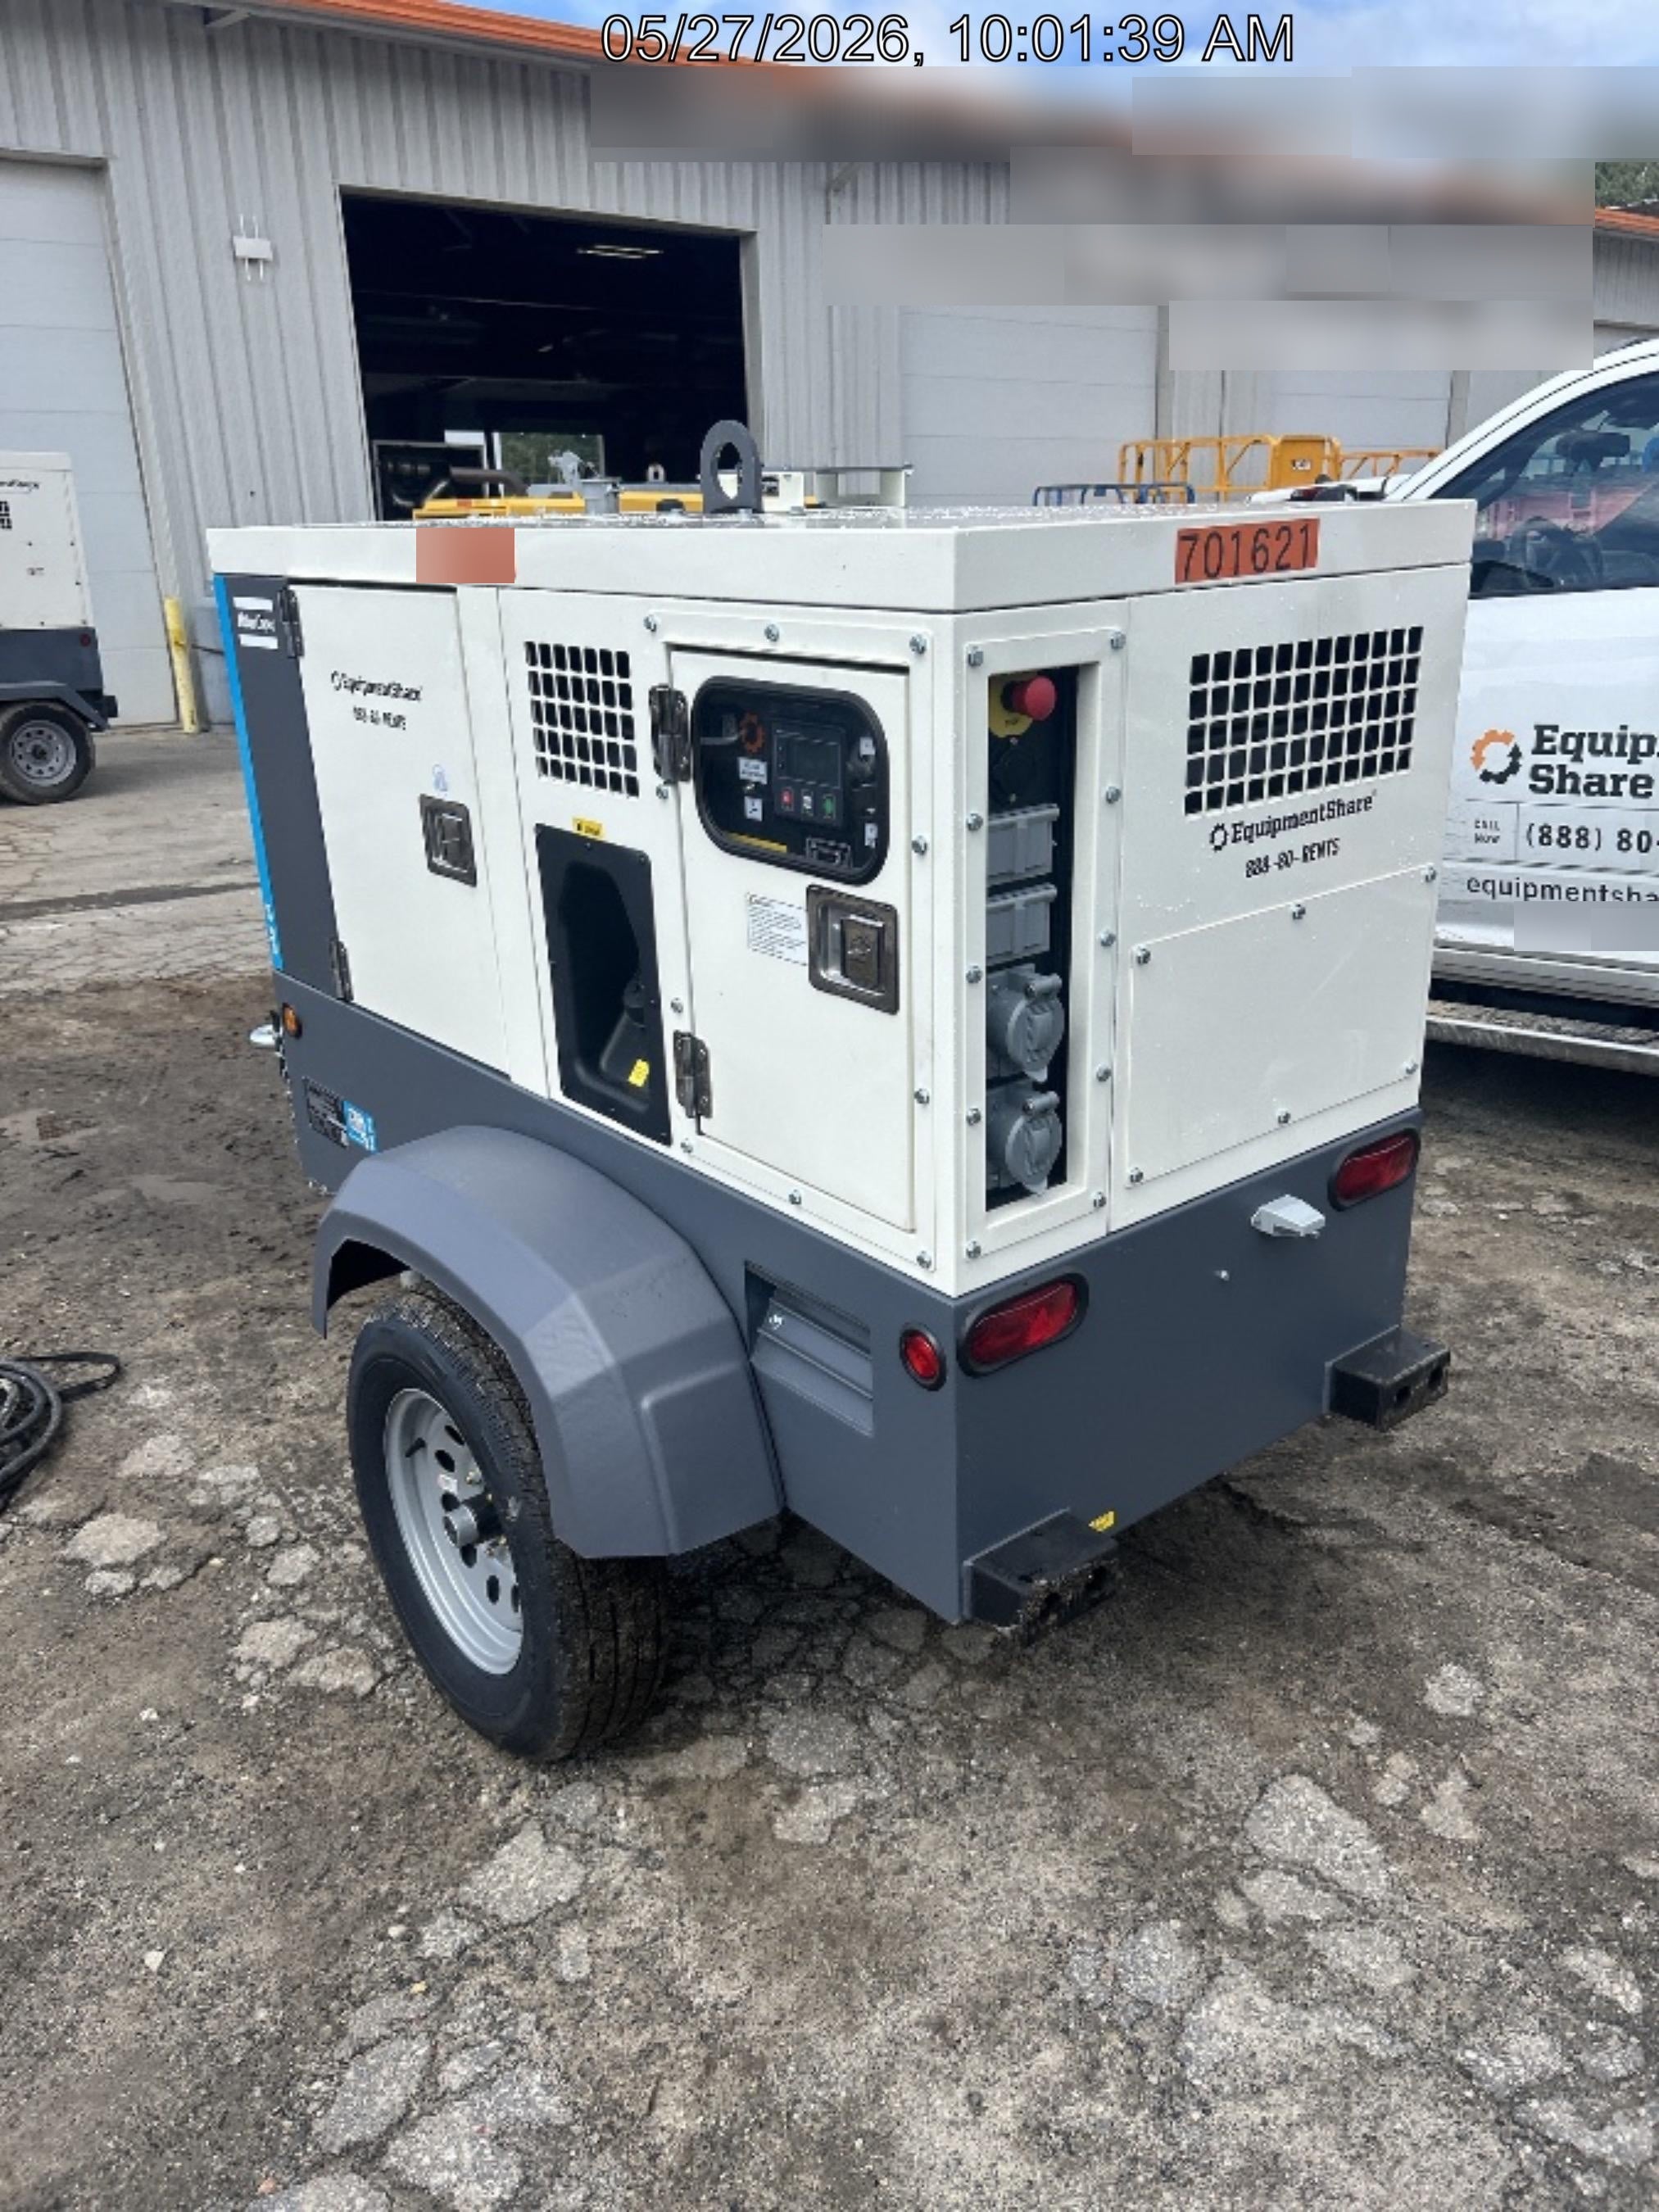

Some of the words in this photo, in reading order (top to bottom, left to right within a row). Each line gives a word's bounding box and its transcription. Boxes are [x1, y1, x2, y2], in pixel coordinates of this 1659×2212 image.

[1179, 523, 1310, 581] 701621
[1531, 724, 1659, 764] Equip
[1529, 764, 1654, 799] Share
[1231, 795, 1373, 843] EquipmentShare
[1526, 823, 1601, 851] (888)
